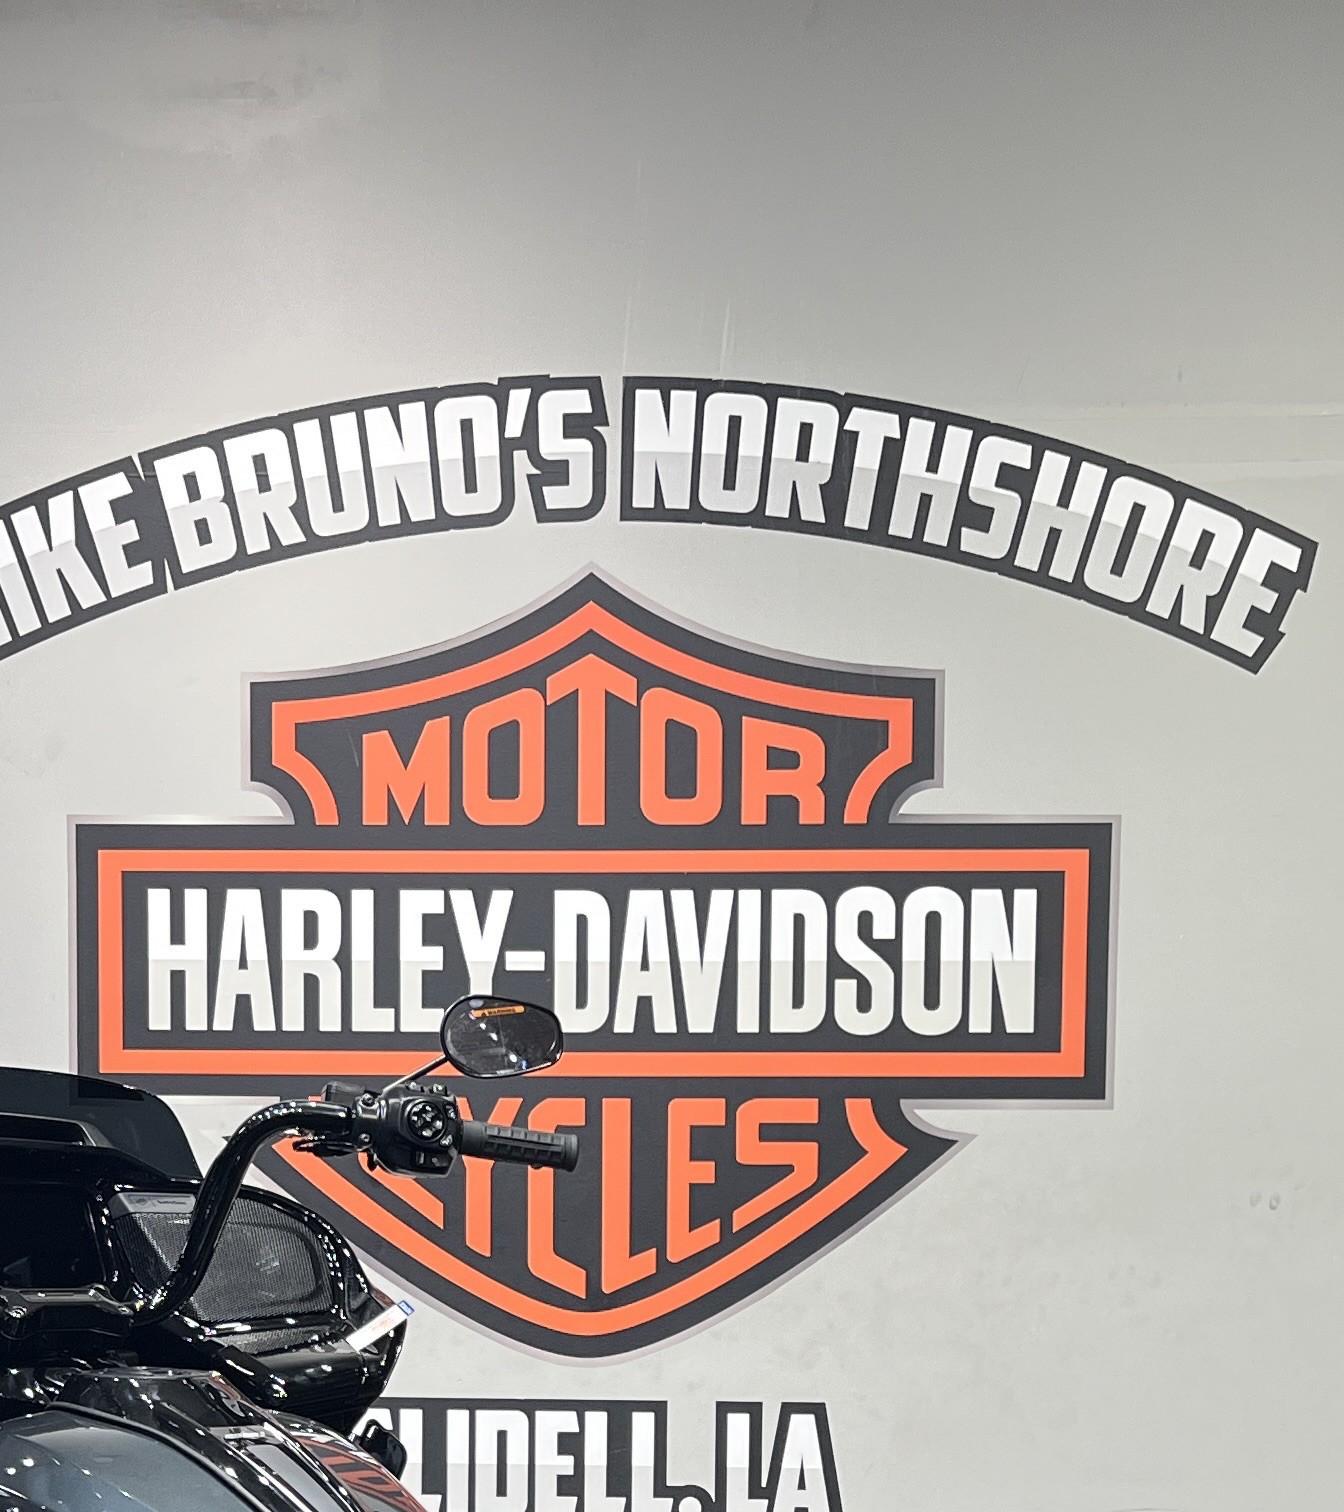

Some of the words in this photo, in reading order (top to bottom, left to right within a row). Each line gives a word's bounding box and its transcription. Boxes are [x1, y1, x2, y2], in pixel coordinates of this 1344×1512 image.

[153, 386, 596, 575] BRUNO'S
[631, 388, 1303, 658] NORTHSHORE
[361, 652, 826, 826] MOTOR
[145, 885, 1039, 1035] HARLEY-DAVIDSON
